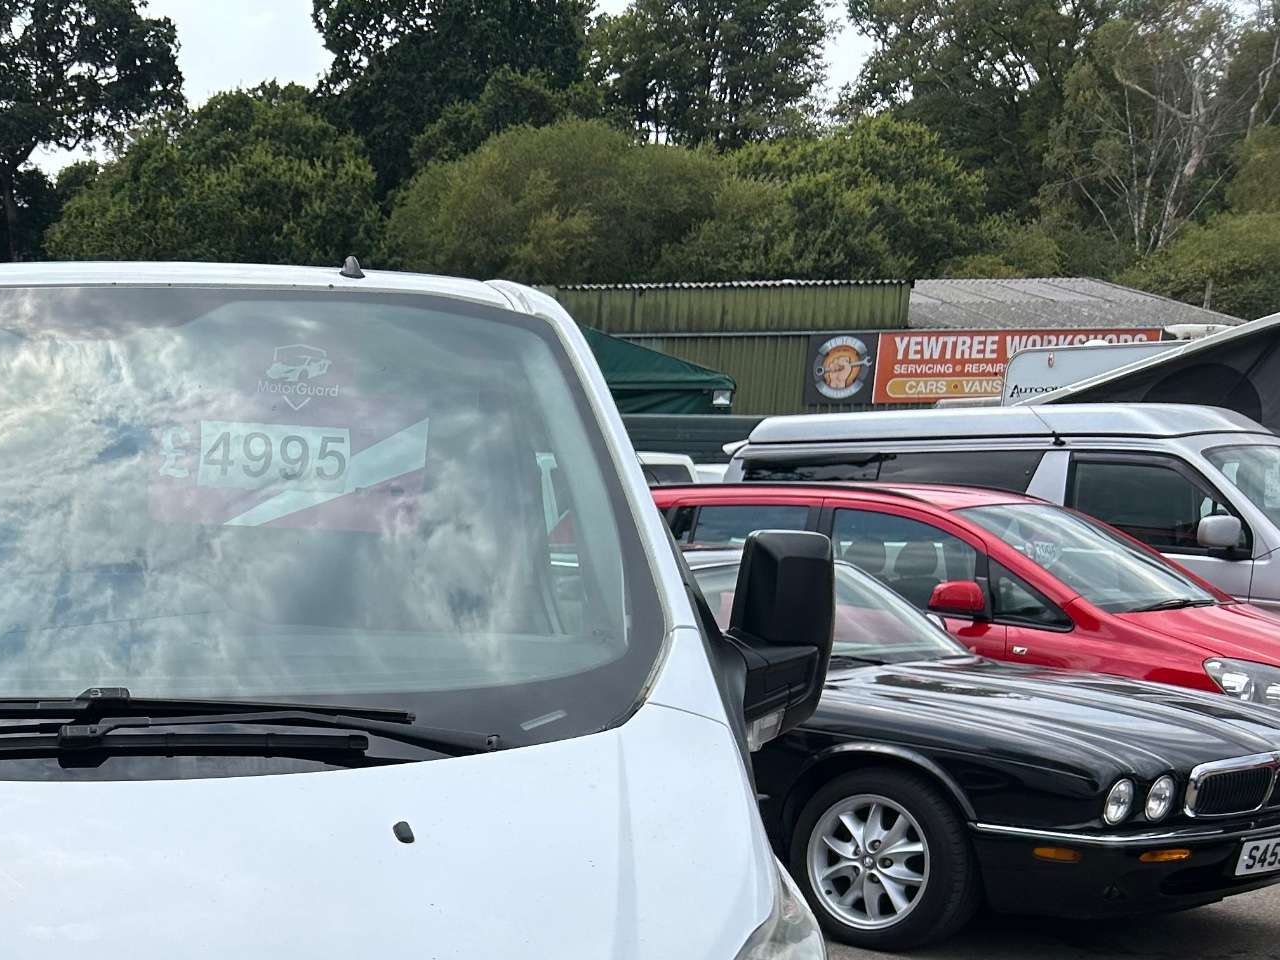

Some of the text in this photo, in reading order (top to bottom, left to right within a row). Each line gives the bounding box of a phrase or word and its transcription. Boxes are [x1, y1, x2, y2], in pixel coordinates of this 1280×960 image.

[894, 336, 999, 360] YEWTREE
[893, 363, 1007, 374] SERVICING REPAIR
[257, 380, 340, 397] MotorGuard
[905, 380, 1002, 393] CARS VANS
